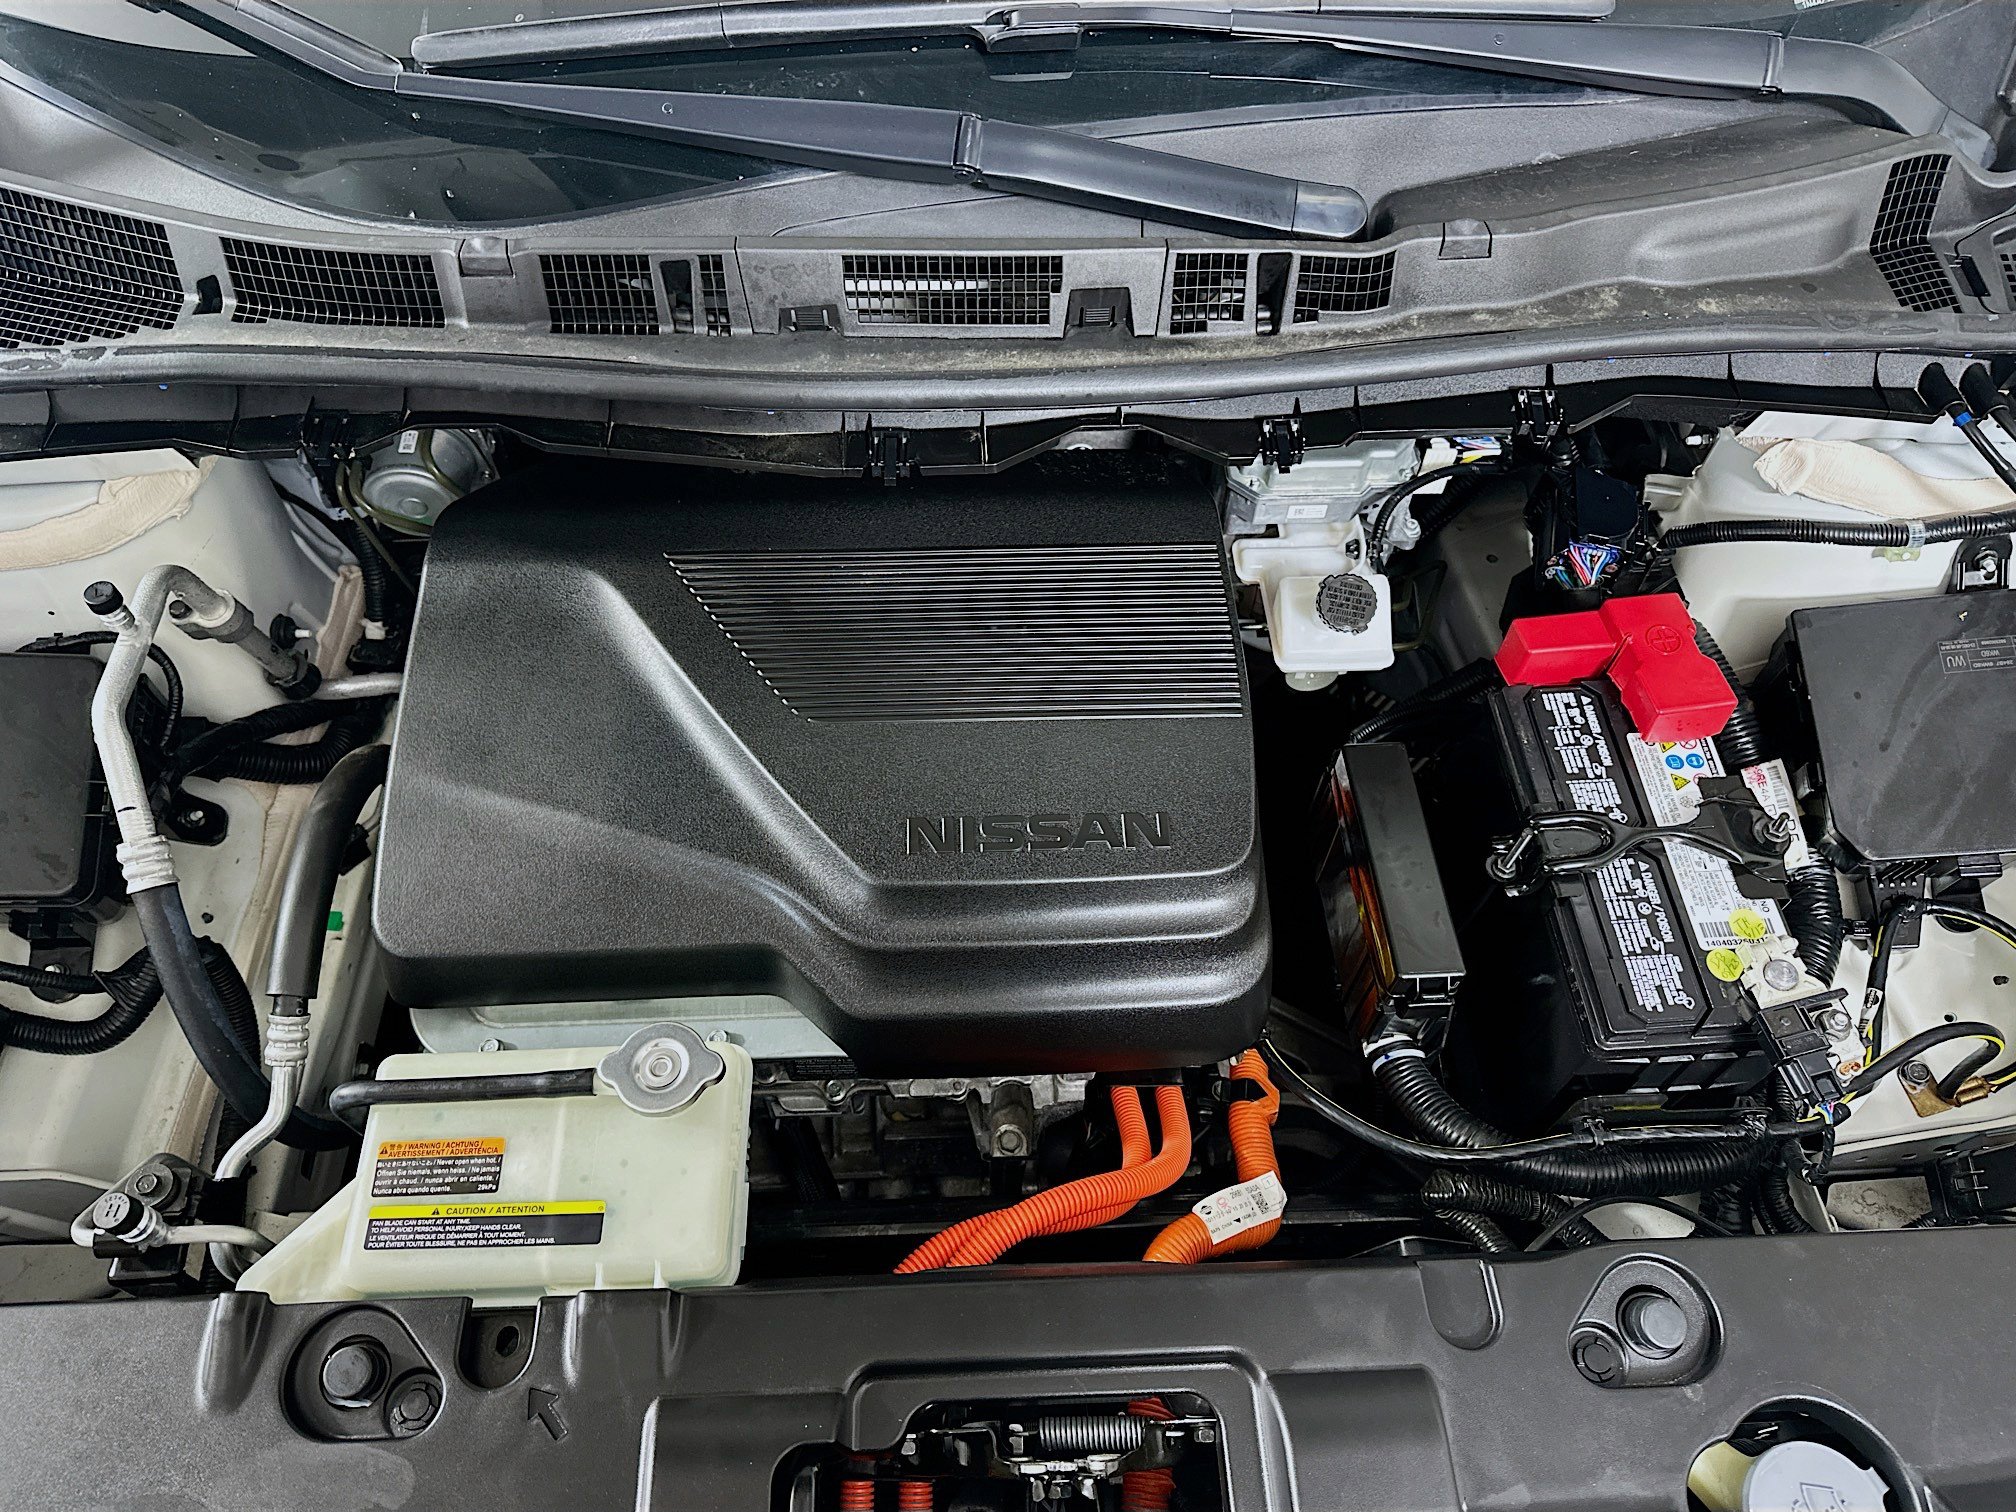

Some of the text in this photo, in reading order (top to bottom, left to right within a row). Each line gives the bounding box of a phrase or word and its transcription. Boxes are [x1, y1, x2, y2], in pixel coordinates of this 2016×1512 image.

[1947, 655, 1966, 668] WU
[906, 812, 1171, 854] NISSAN
[407, 1186, 430, 1194] quando
[105, 1204, 120, 1218] H
[446, 1206, 486, 1214] CAUTION
[496, 1206, 544, 1214] ATTENTION
